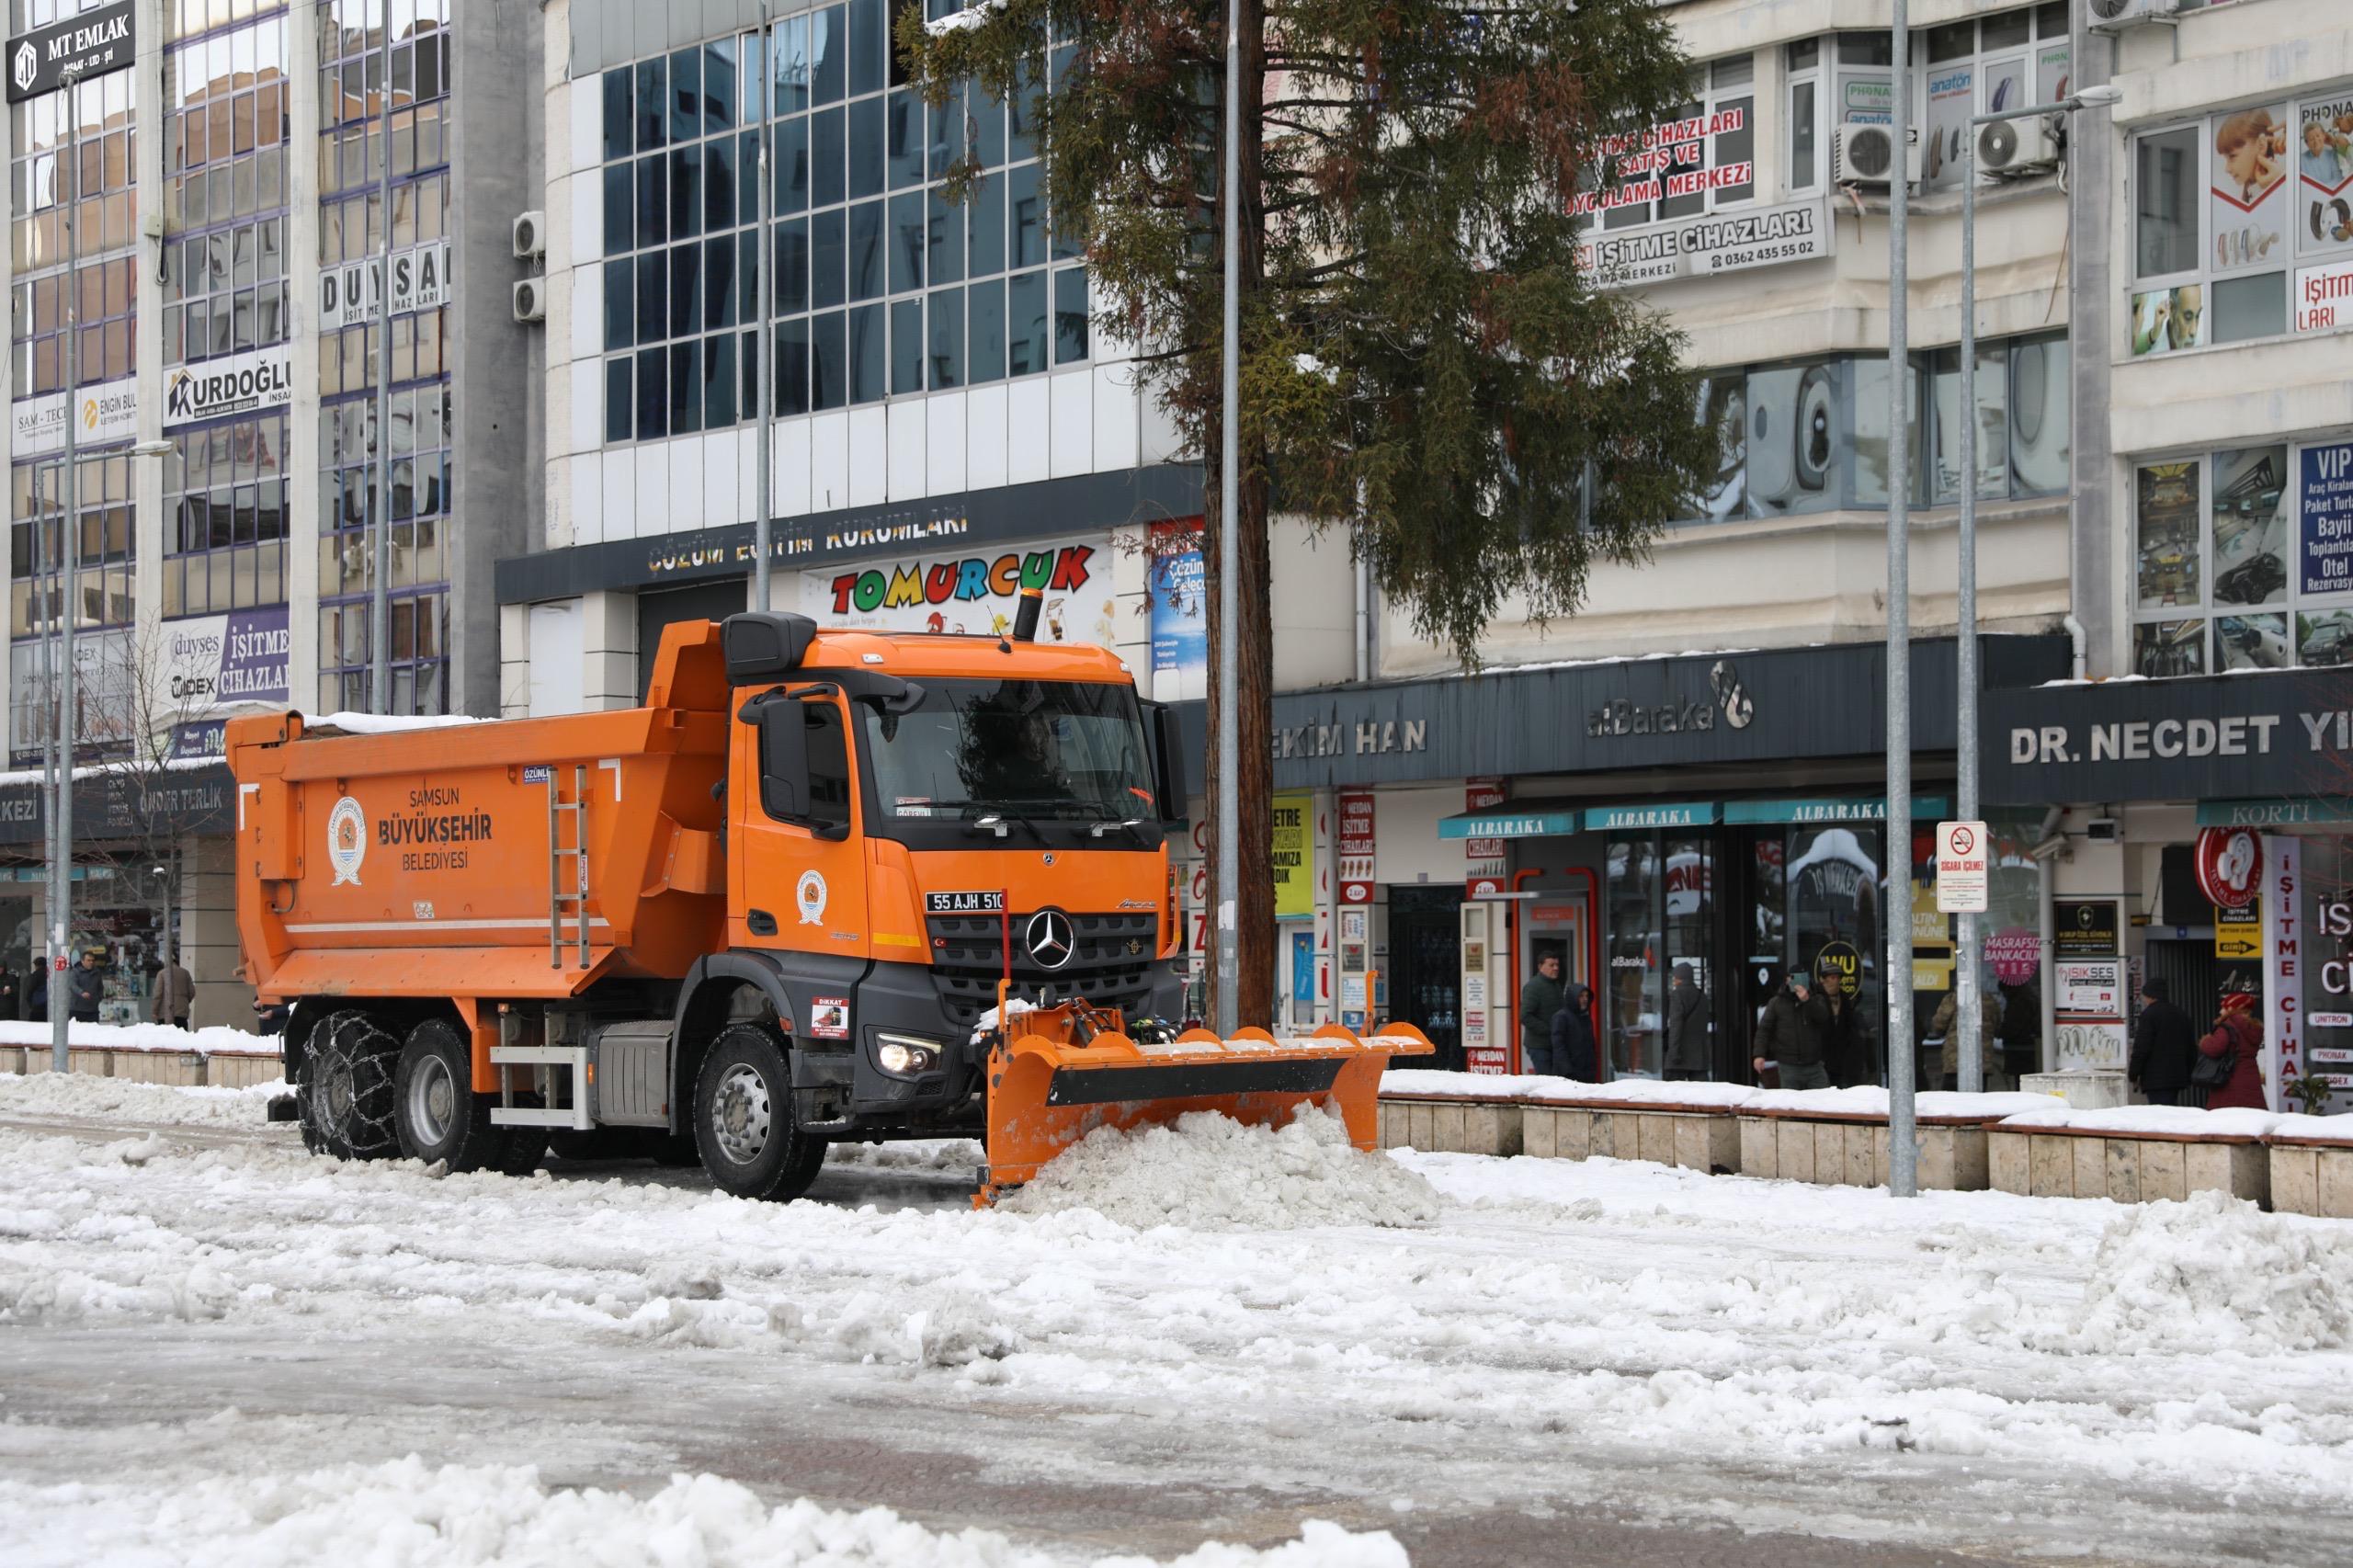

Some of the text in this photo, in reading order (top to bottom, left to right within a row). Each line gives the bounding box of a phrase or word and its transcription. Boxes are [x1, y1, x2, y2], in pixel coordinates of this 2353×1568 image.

[48, 14, 129, 62] MT EMLAK
[89, 53, 100, 67] LTD
[1930, 72, 1971, 95] anatön
[1618, 142, 1699, 178] SATIŞ VE
[1667, 162, 1752, 199] MERKEZİ
[1597, 231, 1678, 269] İŞİTME
[1680, 208, 1814, 255] CİHAZLARI
[1725, 241, 1814, 267] 0362 435 55 02
[2299, 306, 2335, 331] LARI
[100, 392, 121, 415] ENGİN
[18, 413, 39, 429] SAM
[2317, 448, 2352, 480] VIP
[2308, 483, 2325, 494] Araç
[2305, 499, 2332, 514] Paket
[825, 505, 968, 551] KURUMLARI
[2317, 514, 2352, 539] Bayii
[2323, 557, 2348, 577] Otel
[831, 544, 1096, 615] TOMURCUK
[175, 633, 220, 655] duyses
[232, 623, 290, 663] İŞİTME
[172, 675, 216, 699] WIDEX
[1587, 694, 1714, 739] alBaraka
[1356, 720, 1427, 756] HAN
[2010, 710, 2353, 765] DR. NECDET YI
[409, 787, 460, 808] SAMSUN
[1605, 809, 1691, 827] ALBARAKA
[1791, 802, 1884, 822] ALBARAKA
[2233, 800, 2310, 824] KORTİ
[378, 807, 493, 846] BÜYÜKŞEHİR
[1342, 815, 1370, 838] İŞİTME
[1467, 818, 1544, 836] ALBARAKA
[1340, 836, 1374, 854] CİHAZLARI
[402, 846, 469, 871] BELEDİYESİ
[1941, 859, 1984, 872] SİGARA İÇİLMEZ
[933, 894, 950, 910] 55
[954, 893, 979, 910] AJH
[2279, 854, 2297, 977] İŞİTME
[1985, 936, 2040, 949] MASRAFSIZ
[2222, 943, 2247, 952] GİRİŞ
[1611, 955, 1646, 967] alBaraka
[2314, 1016, 2348, 1024] UNITRON
[1476, 1051, 1505, 1062] MEYDAN
